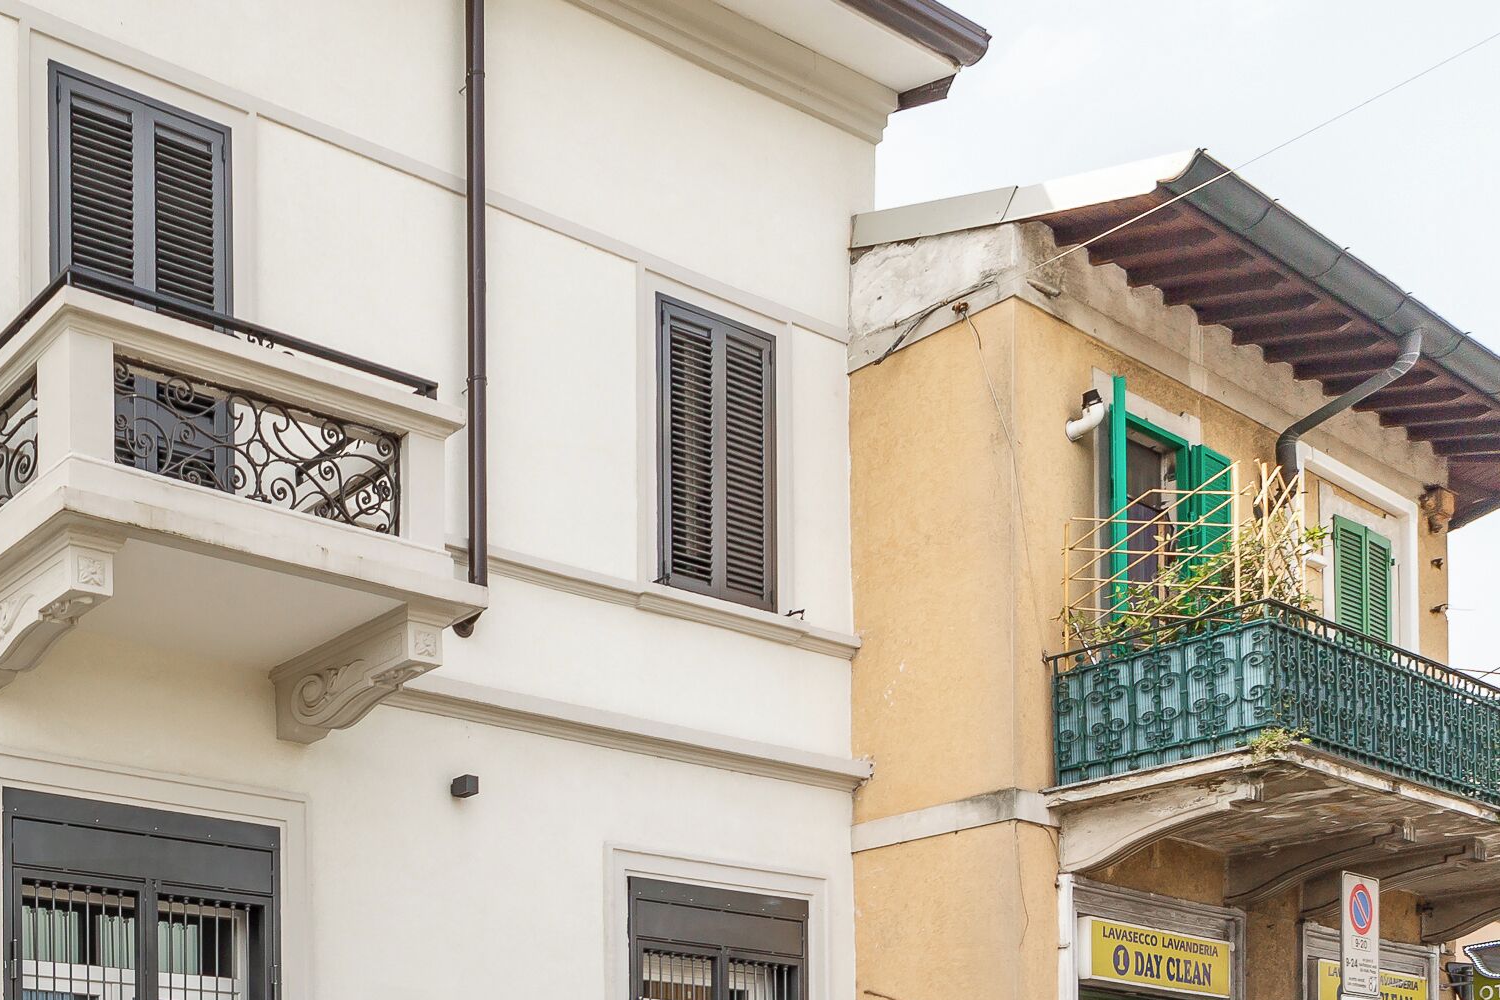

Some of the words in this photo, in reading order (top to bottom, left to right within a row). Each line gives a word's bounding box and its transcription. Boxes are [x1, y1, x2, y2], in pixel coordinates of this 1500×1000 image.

[1102, 926, 1158, 947] LAVASECCO
[1162, 936, 1219, 957] LAVANDERIA
[1134, 950, 1163, 979] DAY
[1166, 956, 1212, 987] CLEAN
